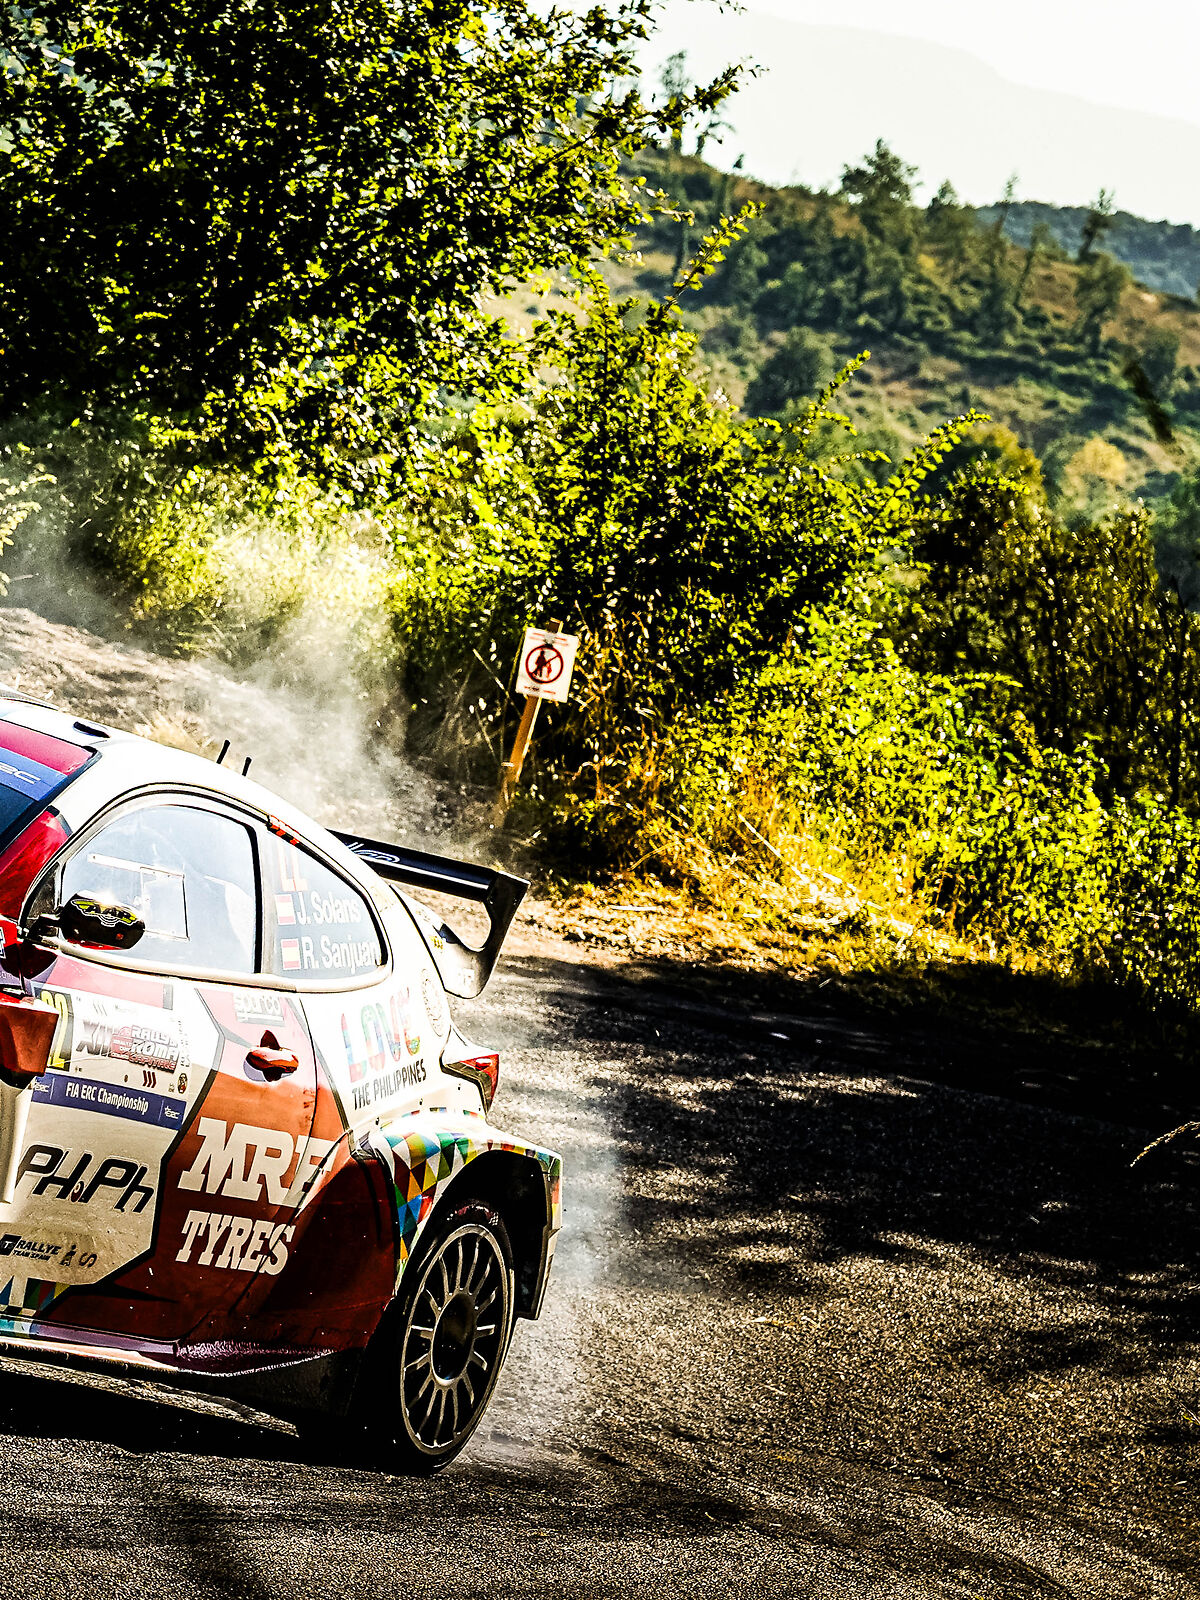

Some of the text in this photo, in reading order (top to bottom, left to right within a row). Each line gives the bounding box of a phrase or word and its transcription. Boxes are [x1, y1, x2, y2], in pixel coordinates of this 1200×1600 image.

[296, 890, 363, 925] J. Solans
[301, 934, 383, 975] R. Sanjuan
[341, 986, 421, 1083] LOVE
[65, 1081, 80, 1099] FIA
[81, 1085, 98, 1102] ERC
[97, 1087, 149, 1115] Championship
[351, 1059, 427, 1110] THE PHILIPPINES
[177, 1116, 340, 1209] MRF
[15, 1240, 62, 1255] RALLYE
[175, 1209, 296, 1276] TYRES
